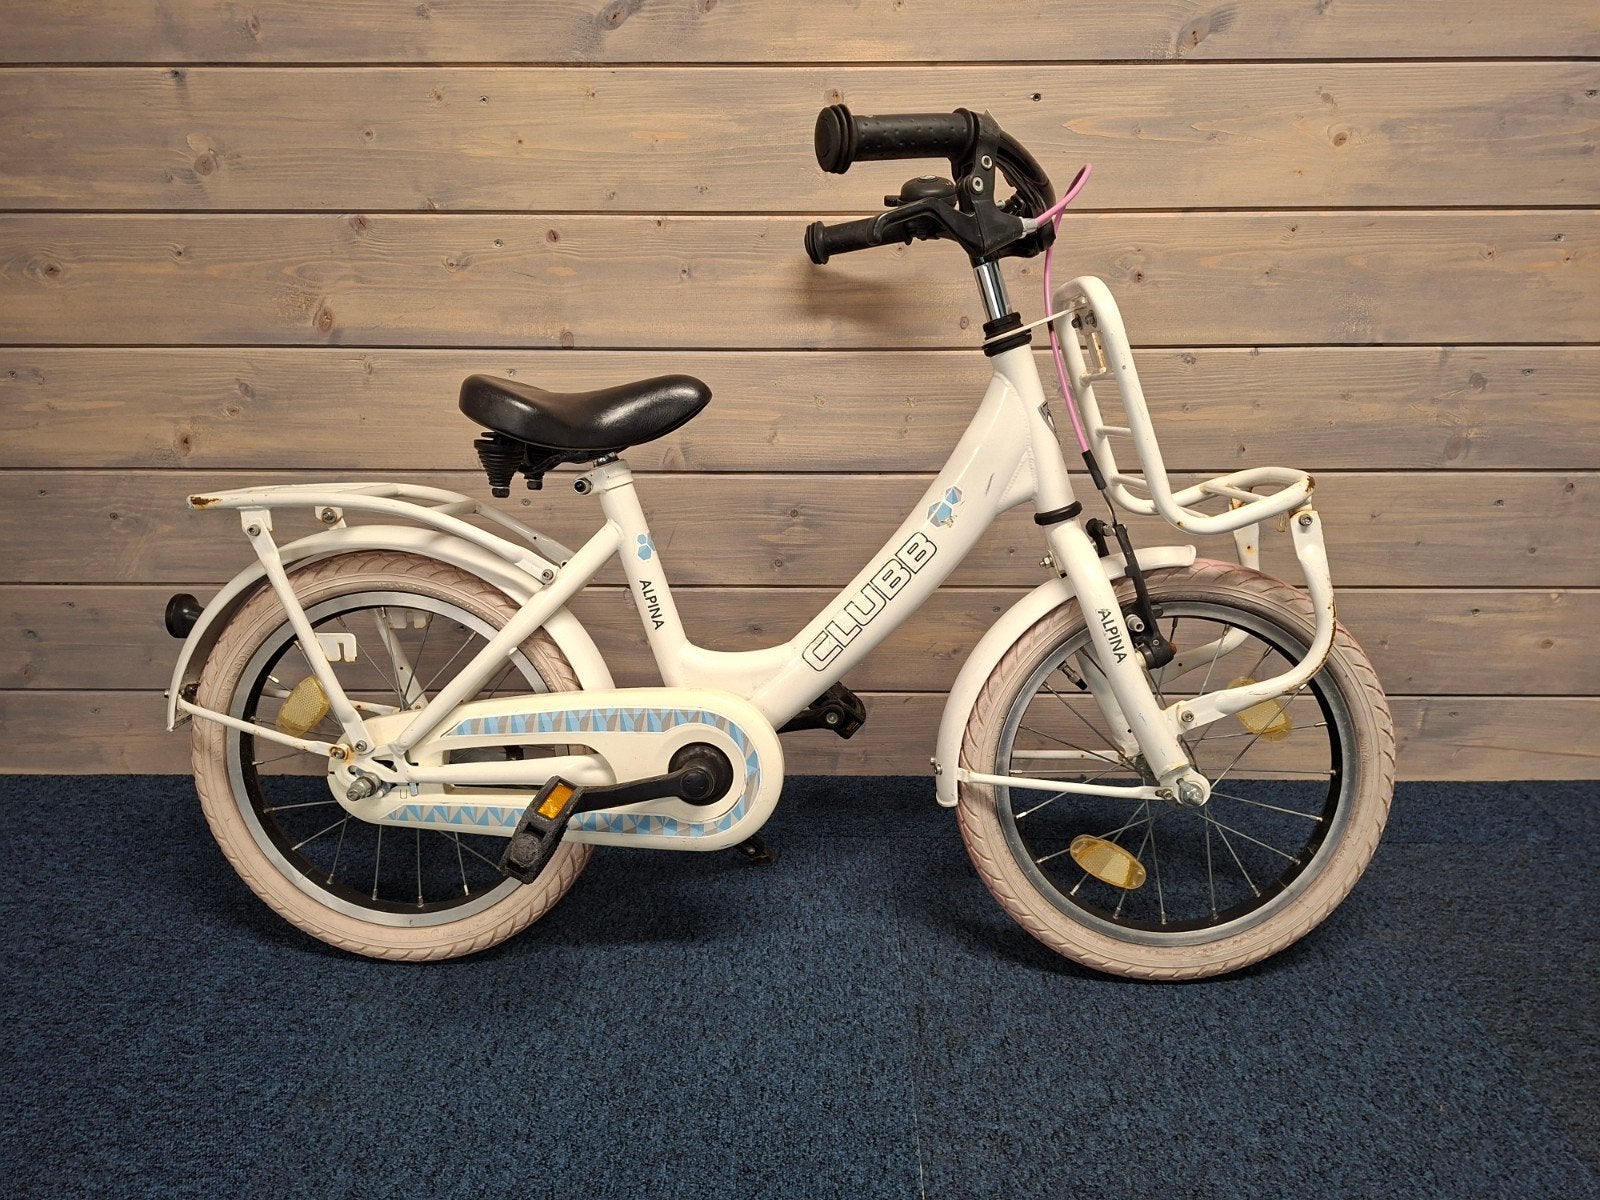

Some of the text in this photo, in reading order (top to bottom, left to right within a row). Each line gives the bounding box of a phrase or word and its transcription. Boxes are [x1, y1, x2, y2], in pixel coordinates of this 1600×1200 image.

[639, 580, 665, 630] ALPINA
[802, 531, 938, 672] CLUBB
[1097, 609, 1128, 664] ALPINA
